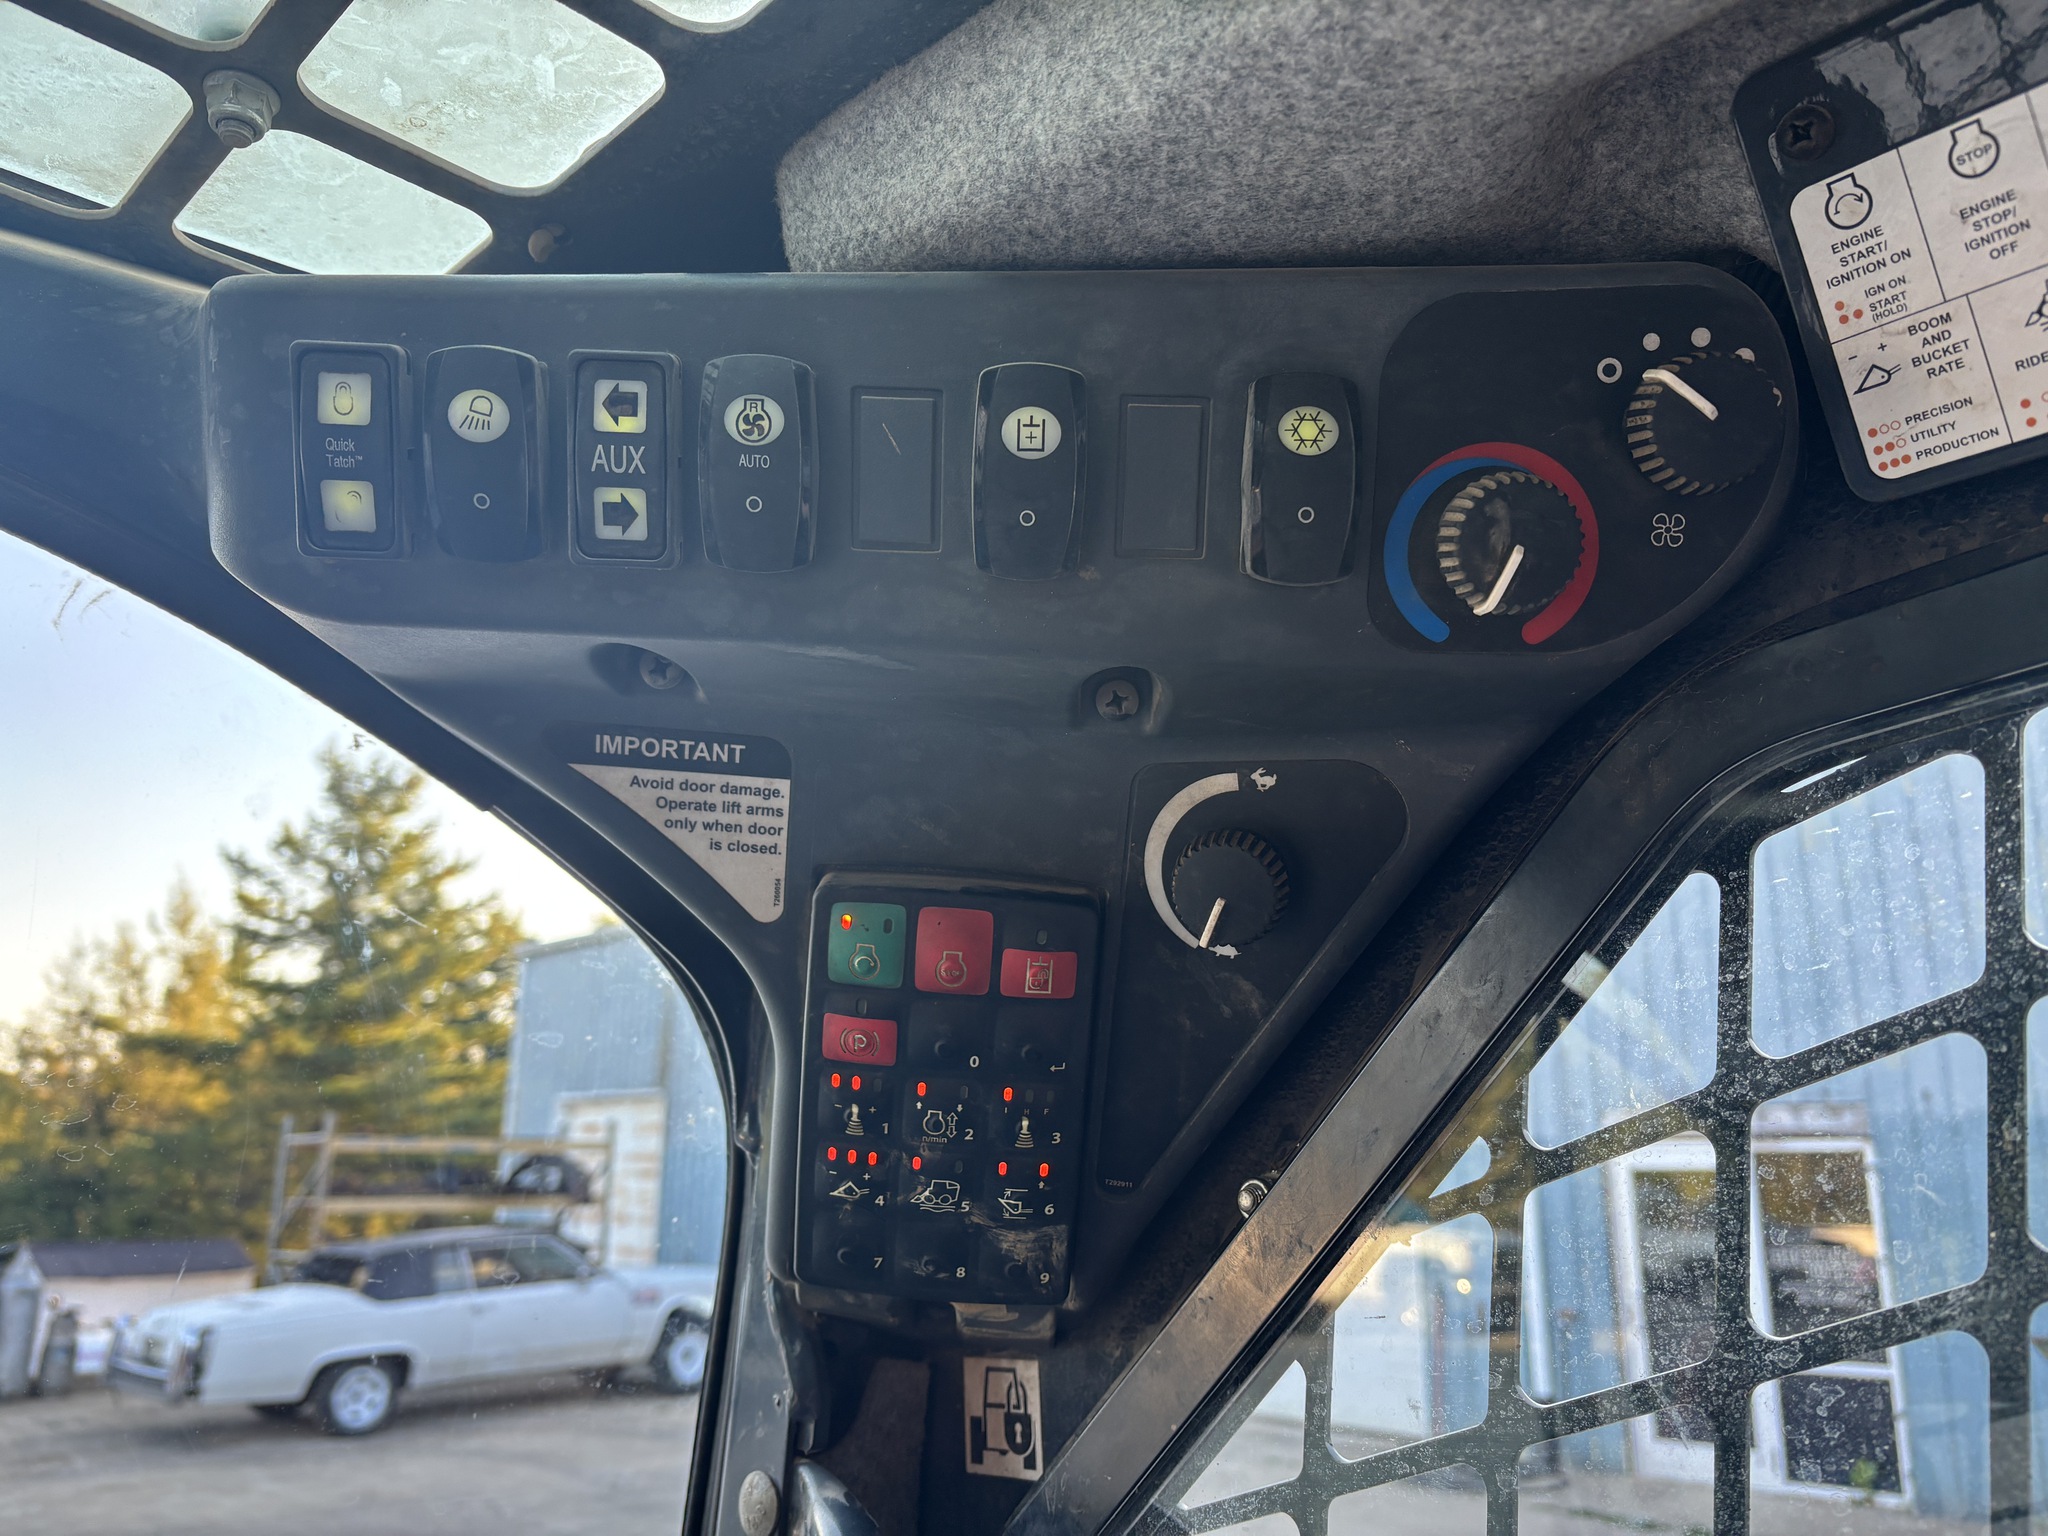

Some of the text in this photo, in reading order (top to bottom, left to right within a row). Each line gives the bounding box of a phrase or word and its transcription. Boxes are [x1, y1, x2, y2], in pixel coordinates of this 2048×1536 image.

[1956, 143, 1992, 166] STOP
[1959, 188, 2018, 221] ENGINE
[1972, 205, 2017, 232] STOP/
[1831, 225, 1884, 254] ENGINE
[1964, 218, 2032, 253] IGNITION
[1839, 240, 1888, 267] START/
[1989, 240, 2019, 260] OFF
[1826, 248, 1912, 289] IGNITION ON
[1864, 275, 1907, 299] IGN ON
[1869, 290, 1907, 312] START
[1872, 303, 1908, 323] (HOLD)
[1907, 312, 1952, 336] BOOM
[1922, 329, 1952, 349] AND
[1911, 338, 1970, 368] BUCKET
[2015, 351, 2048, 372] RIDE
[1926, 357, 1966, 379] RATE
[749, 402, 758, 412] R
[1905, 396, 1974, 426] PRECISION
[1910, 420, 1957, 443] UTILITY
[325, 437, 355, 452] Quick
[1916, 427, 2000, 460] PRODUCTION
[591, 445, 646, 475] AUX
[739, 453, 770, 468] AUTO
[595, 734, 746, 764] IMPORTANT
[630, 775, 785, 799] Avoid door damage.
[656, 796, 784, 818] Operate lift arms
[664, 818, 784, 837] only when door
[709, 838, 782, 855] is closed.
[854, 1034, 867, 1052] P
[969, 1055, 980, 1068] 0
[881, 1123, 889, 1134] 1
[964, 1128, 974, 1141] 2
[1051, 1132, 1061, 1144] 3
[874, 1194, 885, 1206] 4
[960, 1200, 970, 1213] 5
[1044, 1203, 1055, 1216] 6
[873, 1256, 884, 1268] 7
[955, 1266, 966, 1279] 8
[1039, 1272, 1050, 1285] 9
